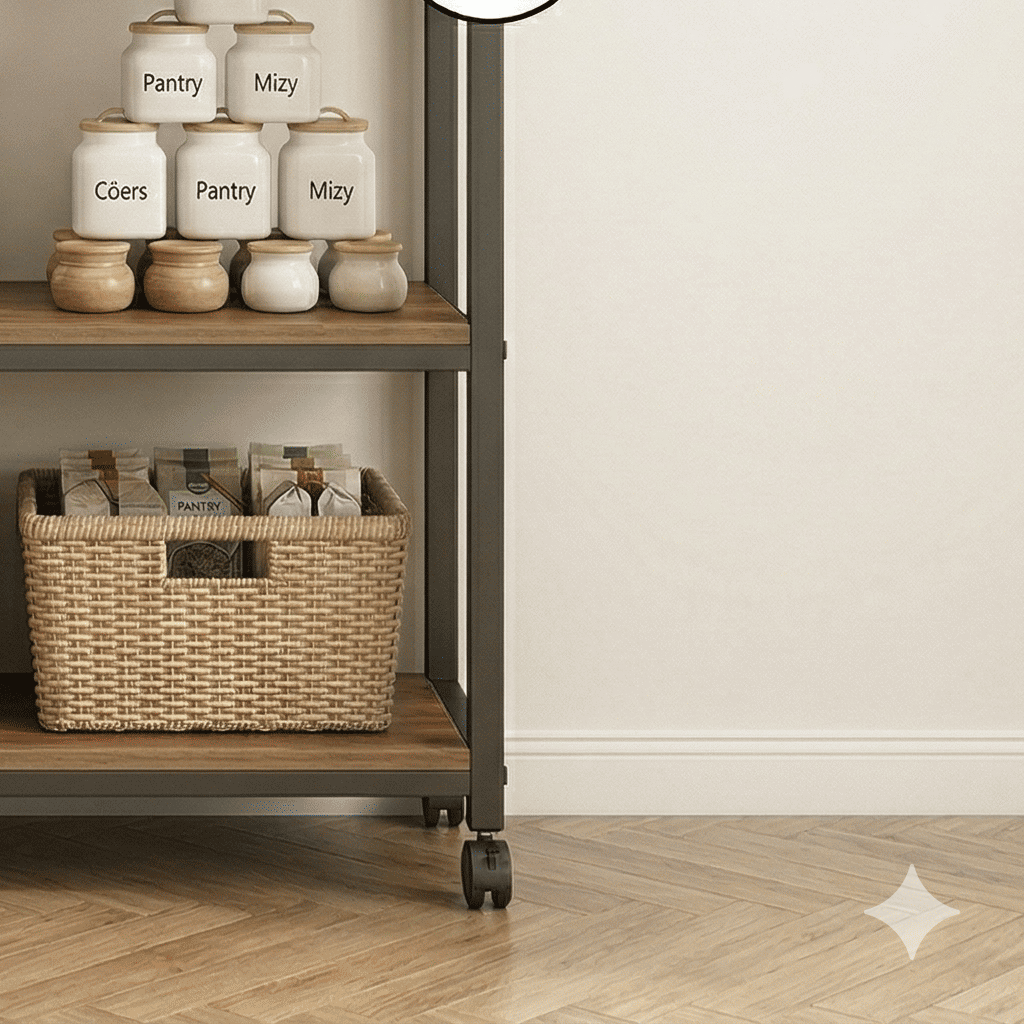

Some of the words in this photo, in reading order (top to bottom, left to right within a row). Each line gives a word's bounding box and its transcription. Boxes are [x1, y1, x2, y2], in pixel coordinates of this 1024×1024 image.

[143, 73, 203, 97] Pantry
[254, 73, 298, 97] Mizy
[94, 180, 148, 200] Cöers
[196, 180, 256, 205] Pantry
[309, 180, 354, 205] Mizy
